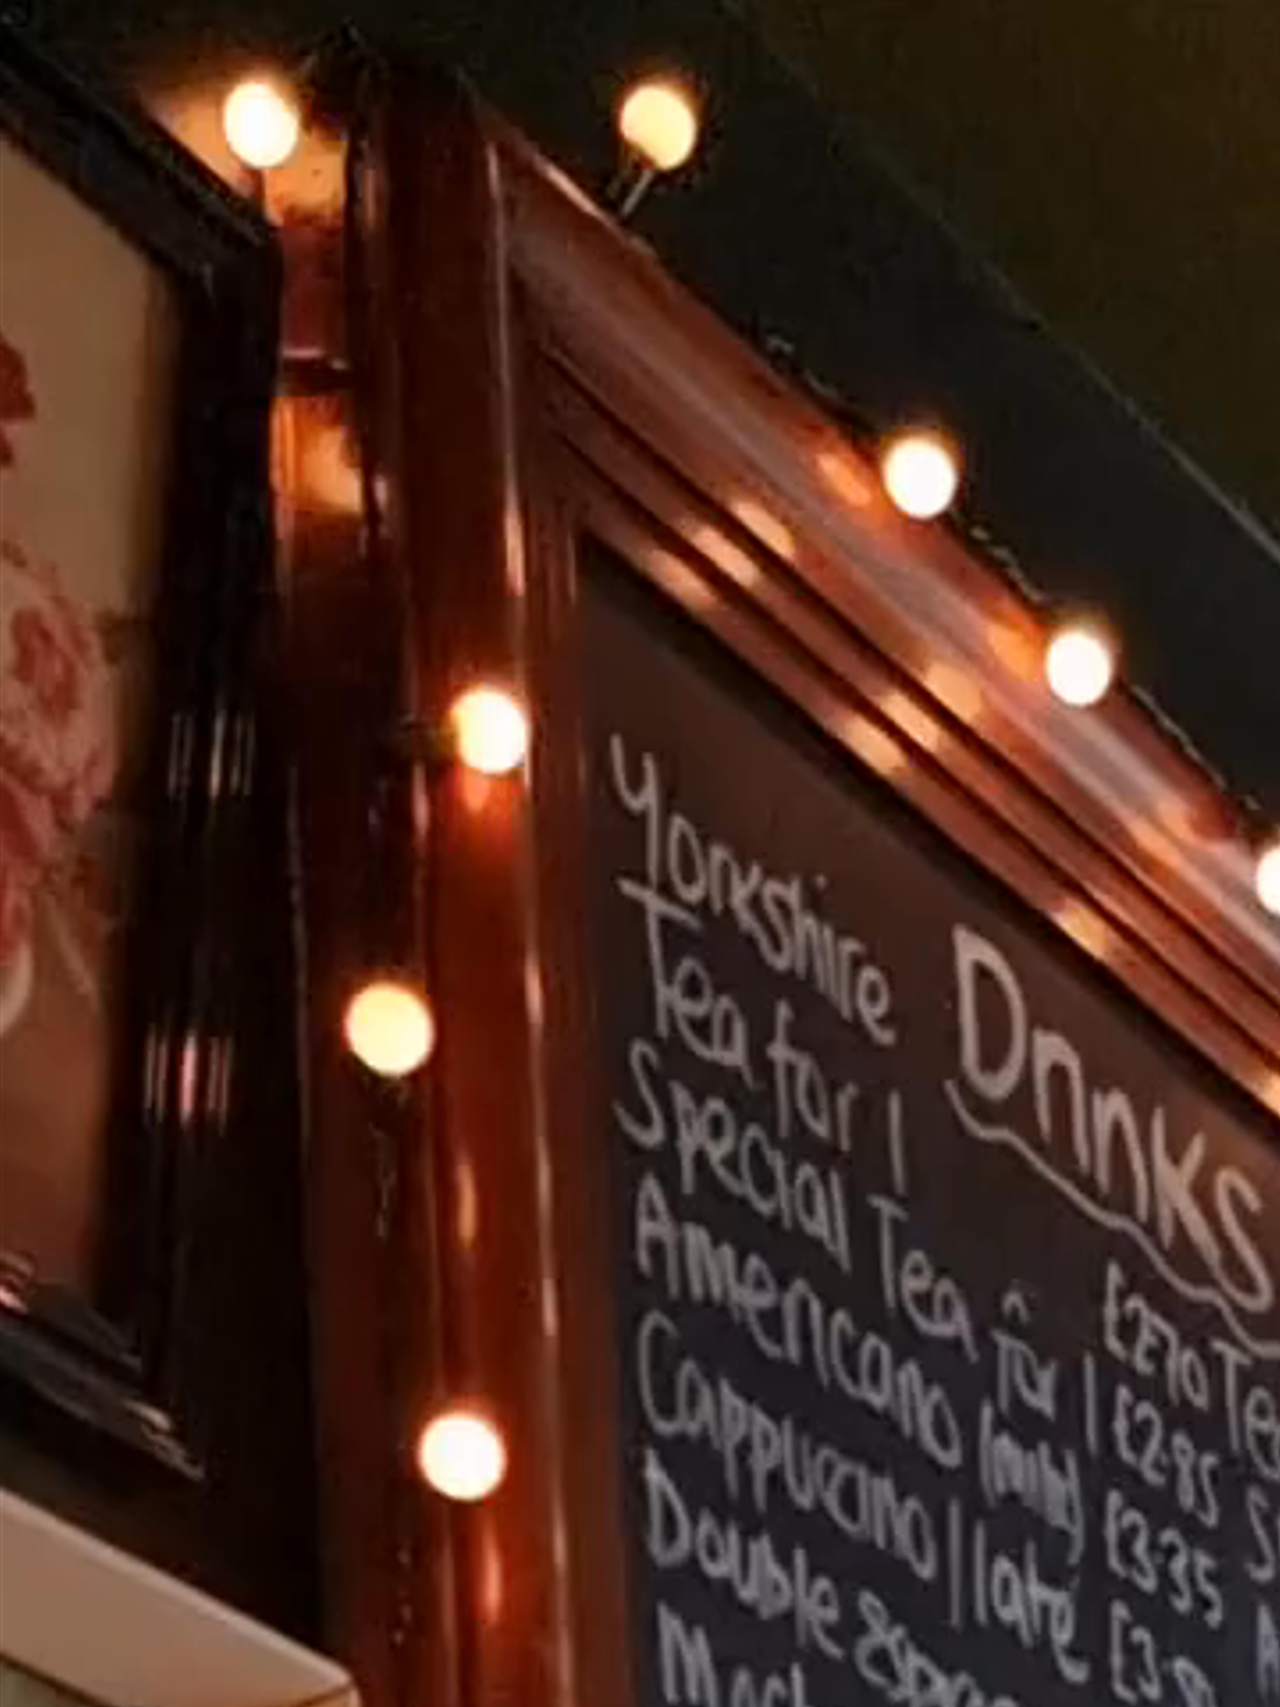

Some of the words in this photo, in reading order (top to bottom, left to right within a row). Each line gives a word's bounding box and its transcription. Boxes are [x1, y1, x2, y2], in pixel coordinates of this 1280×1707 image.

[610, 736, 895, 1044] Yorkshire
[618, 878, 752, 1084] Tea
[766, 999, 859, 1151] for
[616, 1039, 850, 1269] Special
[868, 1194, 977, 1360] Tea
[635, 1177, 961, 1466] Americano
[643, 1451, 842, 1657] Double
